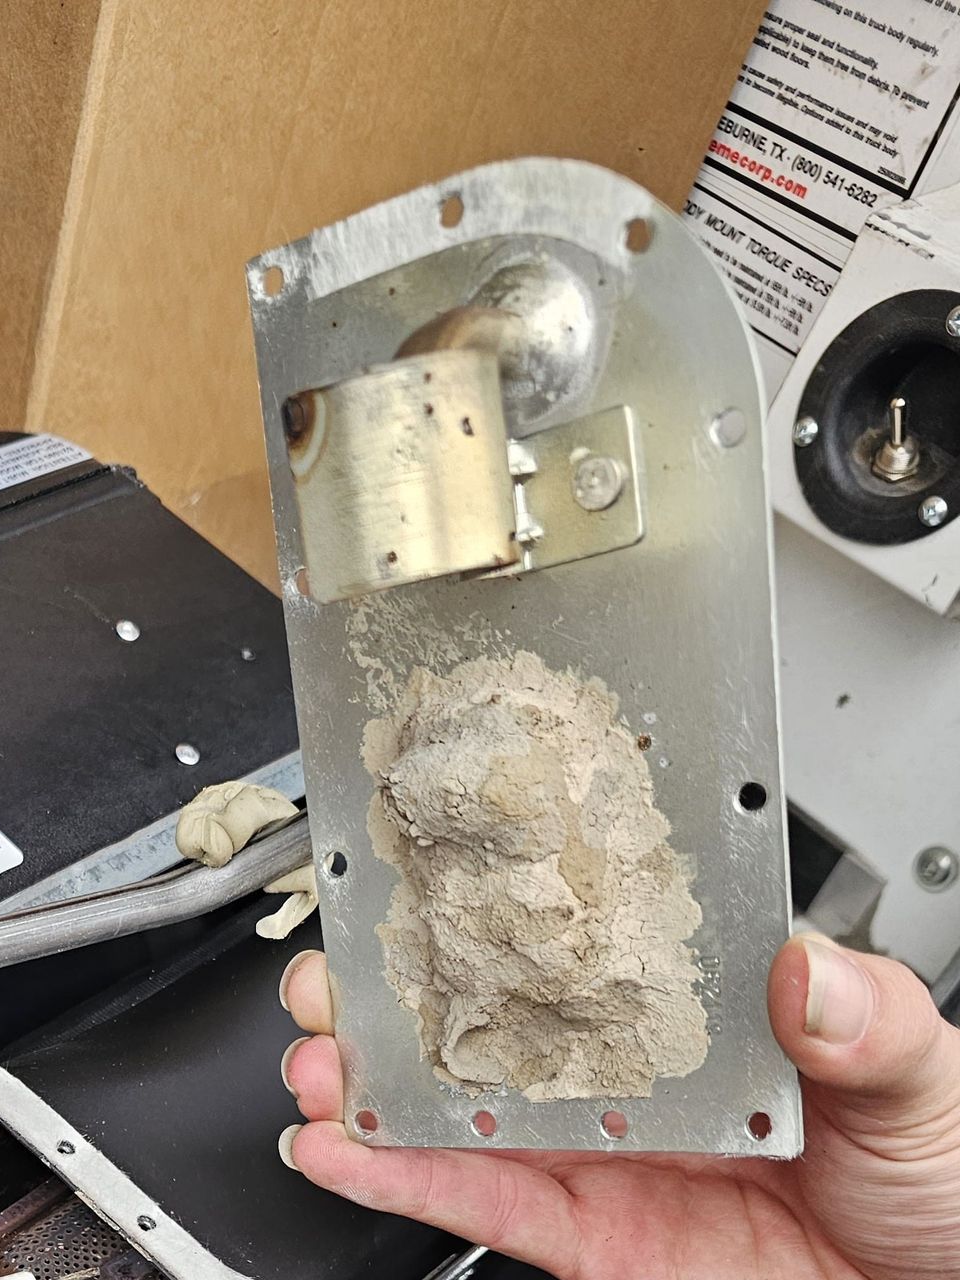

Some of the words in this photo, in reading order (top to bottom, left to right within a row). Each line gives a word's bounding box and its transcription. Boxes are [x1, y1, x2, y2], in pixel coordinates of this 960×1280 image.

[771, 45, 790, 59] wood
[789, 52, 810, 69] floors.
[783, 20, 807, 34] proper
[806, 31, 821, 42] seal
[821, 38, 836, 49] and
[844, 8, 853, 18] on
[853, 11, 868, 24] this
[868, 17, 887, 33] truck
[887, 25, 906, 43] body
[906, 36, 939, 57] regularly.
[792, 39, 800, 49] to
[801, 42, 817, 58] keep
[818, 51, 834, 65] them
[834, 58, 849, 72] free
[849, 65, 867, 80] from
[867, 74, 890, 92] debris.
[891, 84, 901, 96] To
[900, 91, 930, 109] prevent
[845, 126, 852, 135] to
[852, 130, 865, 141] this
[881, 143, 899, 159] body
[855, 119, 869, 130] and
[868, 125, 882, 138] may
[882, 134, 899, 144] void
[709, 139, 808, 198] emecorp.com
[771, 142, 787, 162] TX
[791, 154, 823, 183] (800)
[822, 170, 878, 208] 541-6282
[704, 214, 746, 243] MOUNT
[746, 237, 792, 273] TORQUE
[792, 266, 832, 297] SPECS
